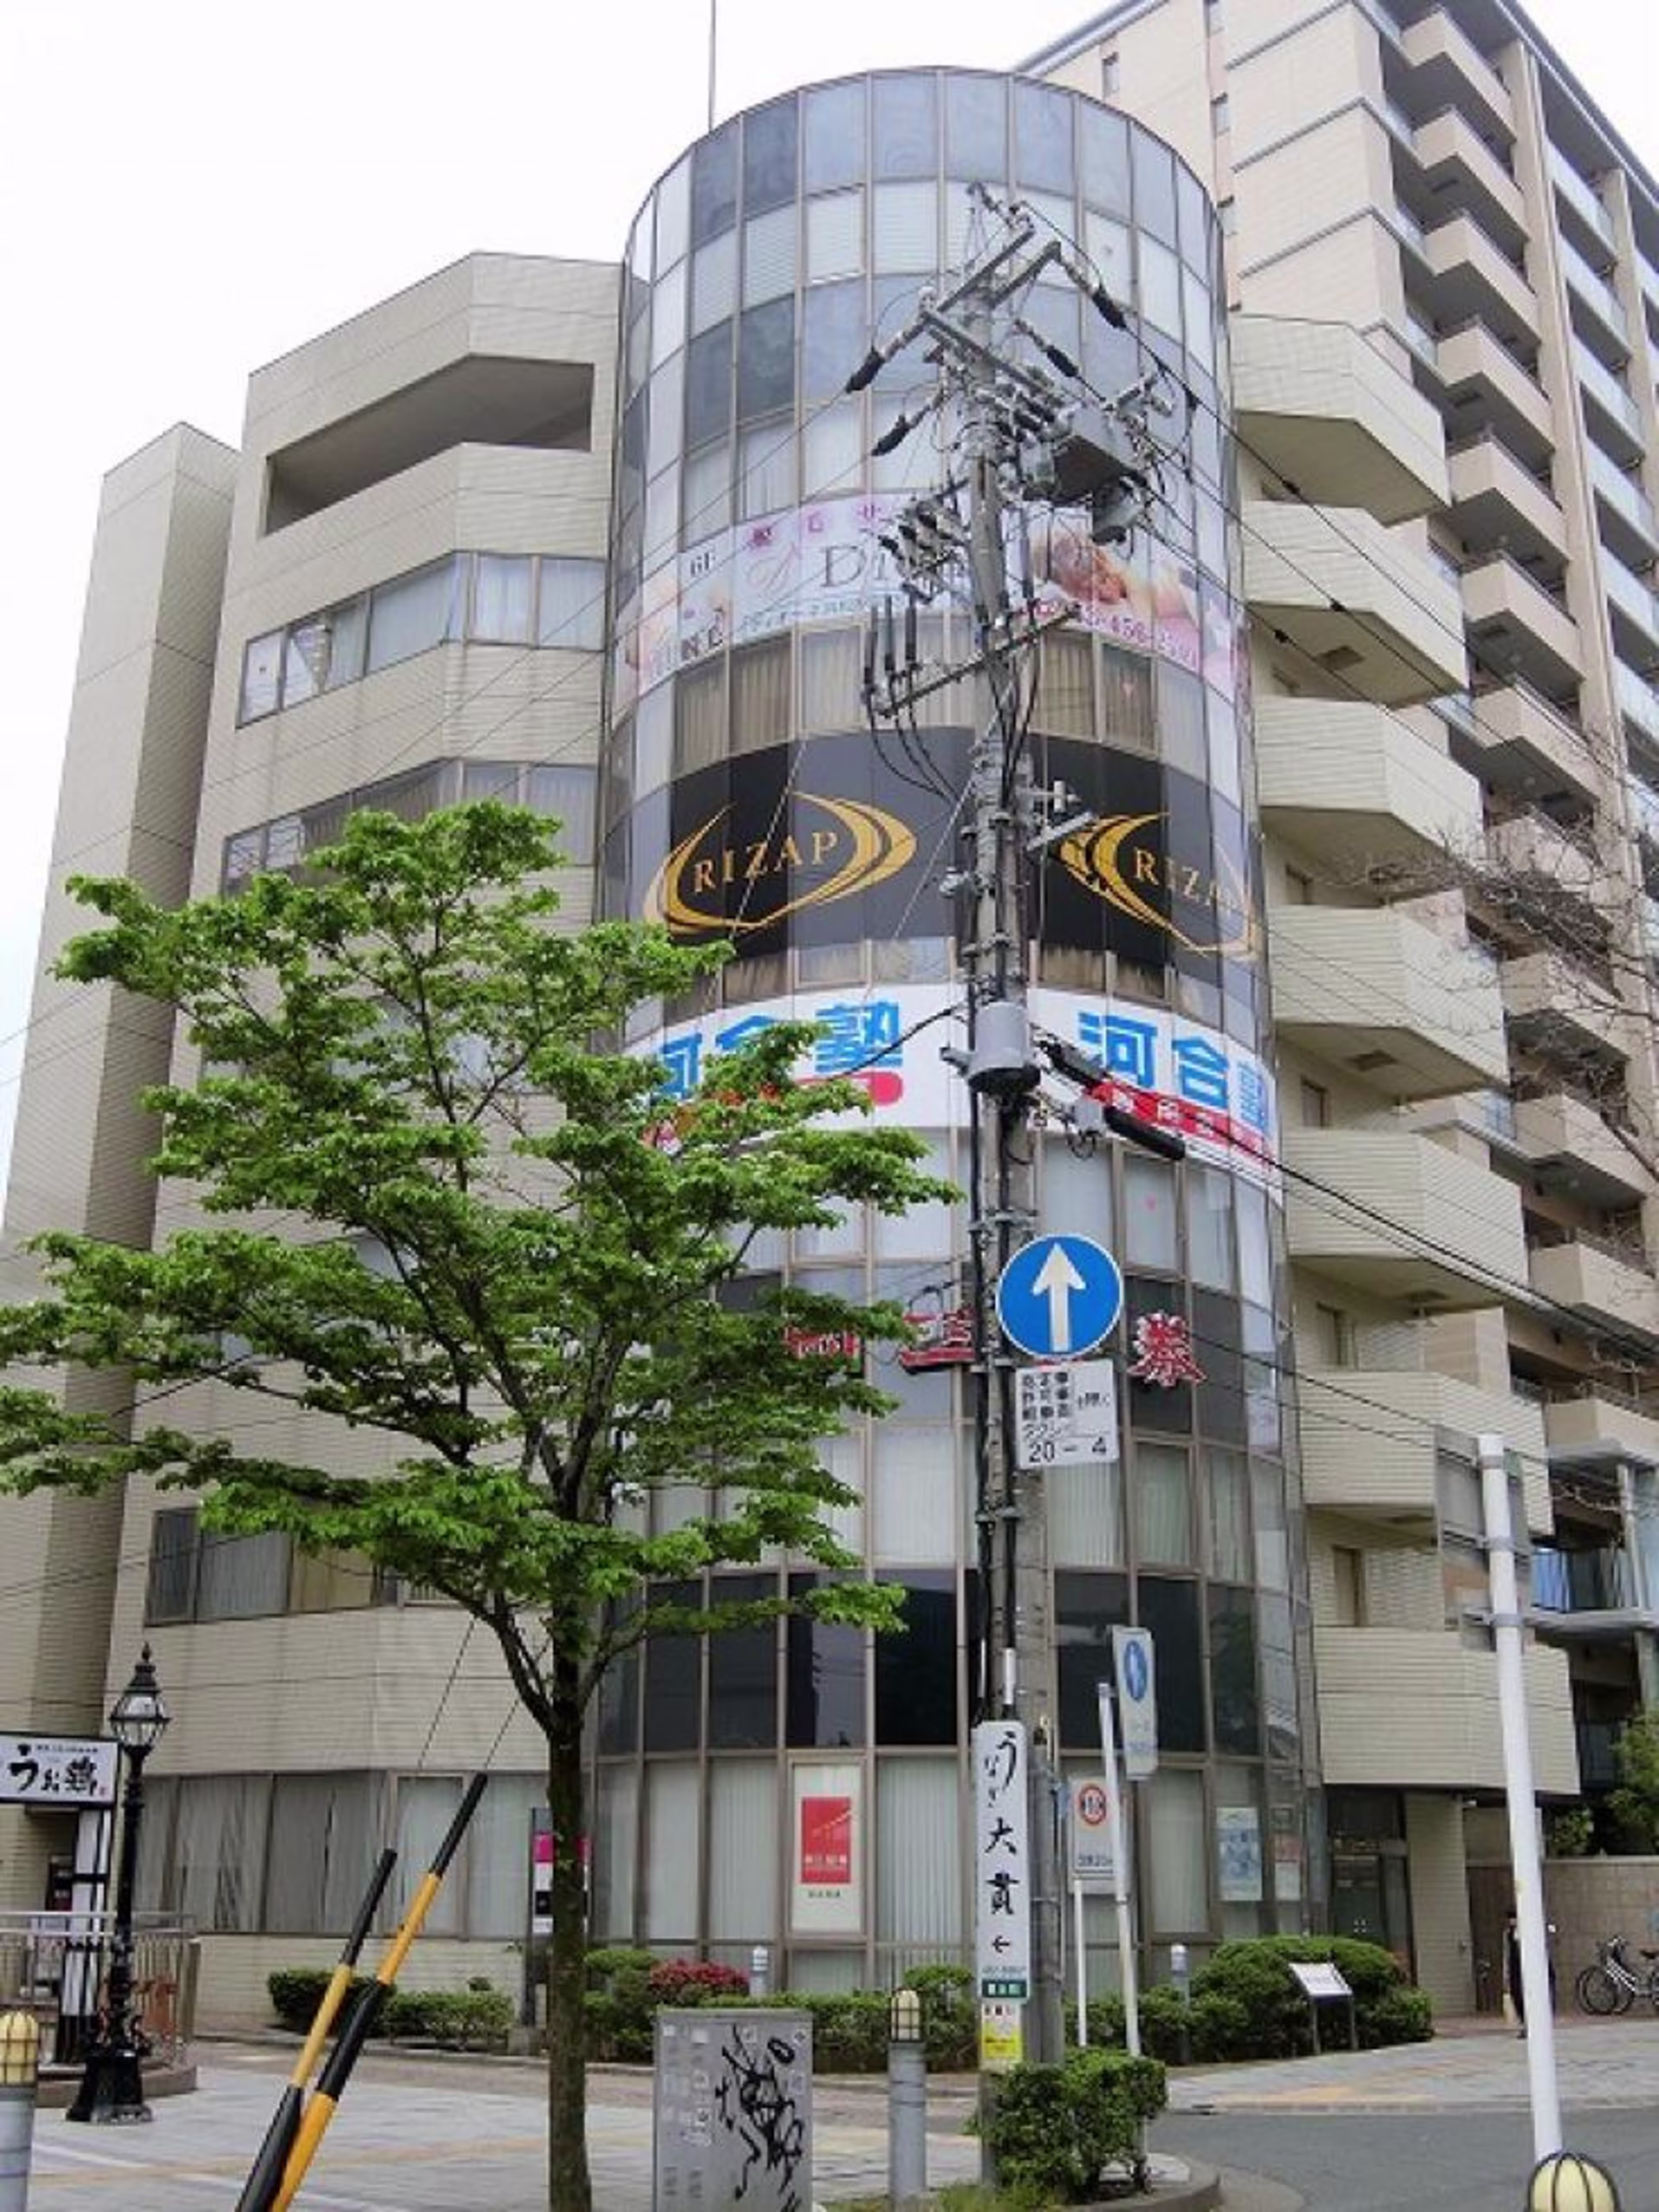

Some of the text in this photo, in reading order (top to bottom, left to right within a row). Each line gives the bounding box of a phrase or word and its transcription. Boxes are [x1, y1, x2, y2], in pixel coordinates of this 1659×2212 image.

[693, 830, 838, 893] RIZAP
[1077, 1012, 1271, 1141] 河合塾
